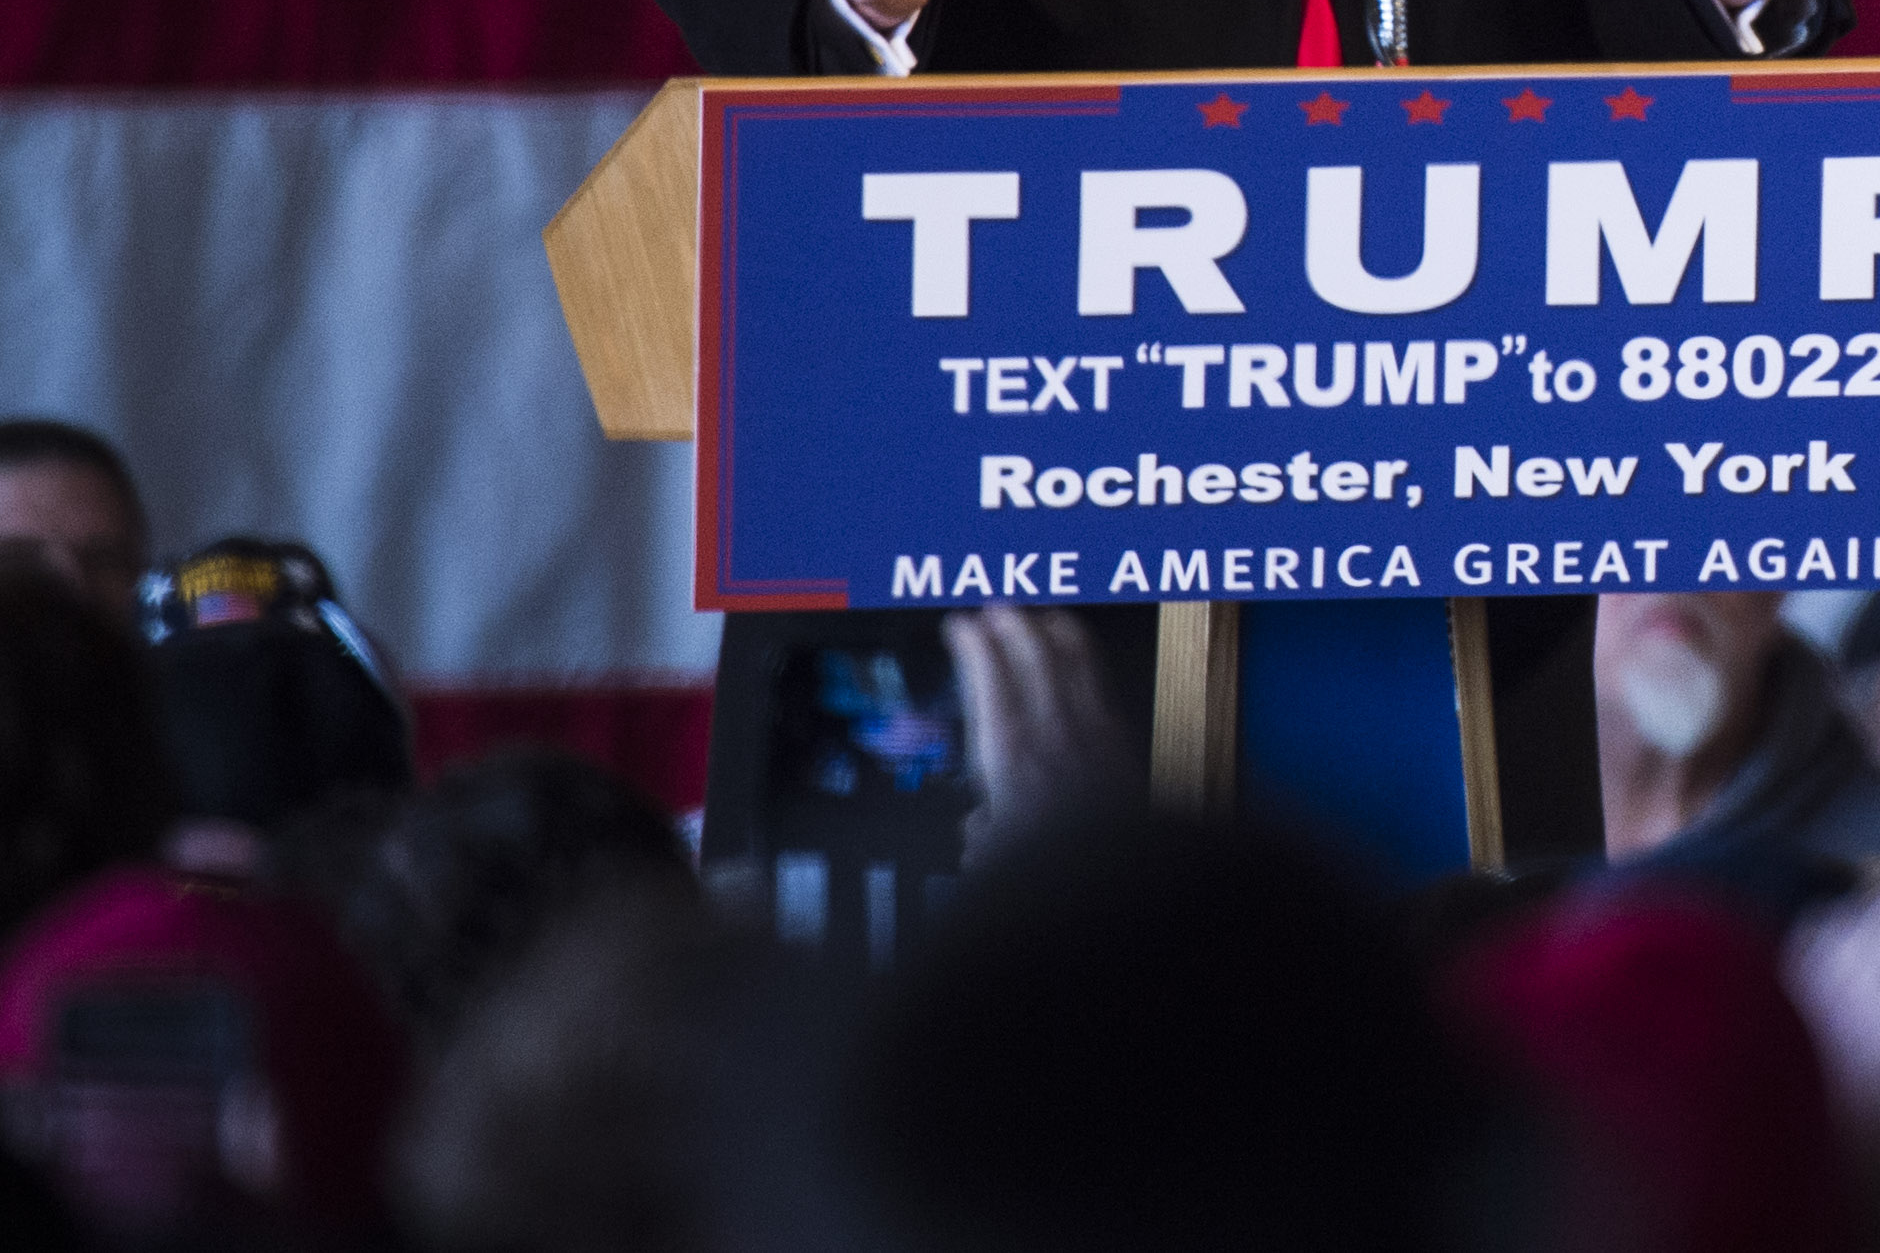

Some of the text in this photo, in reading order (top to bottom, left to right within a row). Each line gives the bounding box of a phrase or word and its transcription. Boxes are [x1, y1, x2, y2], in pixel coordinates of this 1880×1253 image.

[939, 356, 1124, 414] TEXT
[1136, 334, 1527, 409] “TRUMP”
[1528, 349, 1597, 404] to
[980, 440, 1857, 509] Rochester, New York
[892, 550, 1079, 598] MAKE
[1109, 543, 1421, 593] AMERICA
[1453, 539, 1669, 586] GREAT
